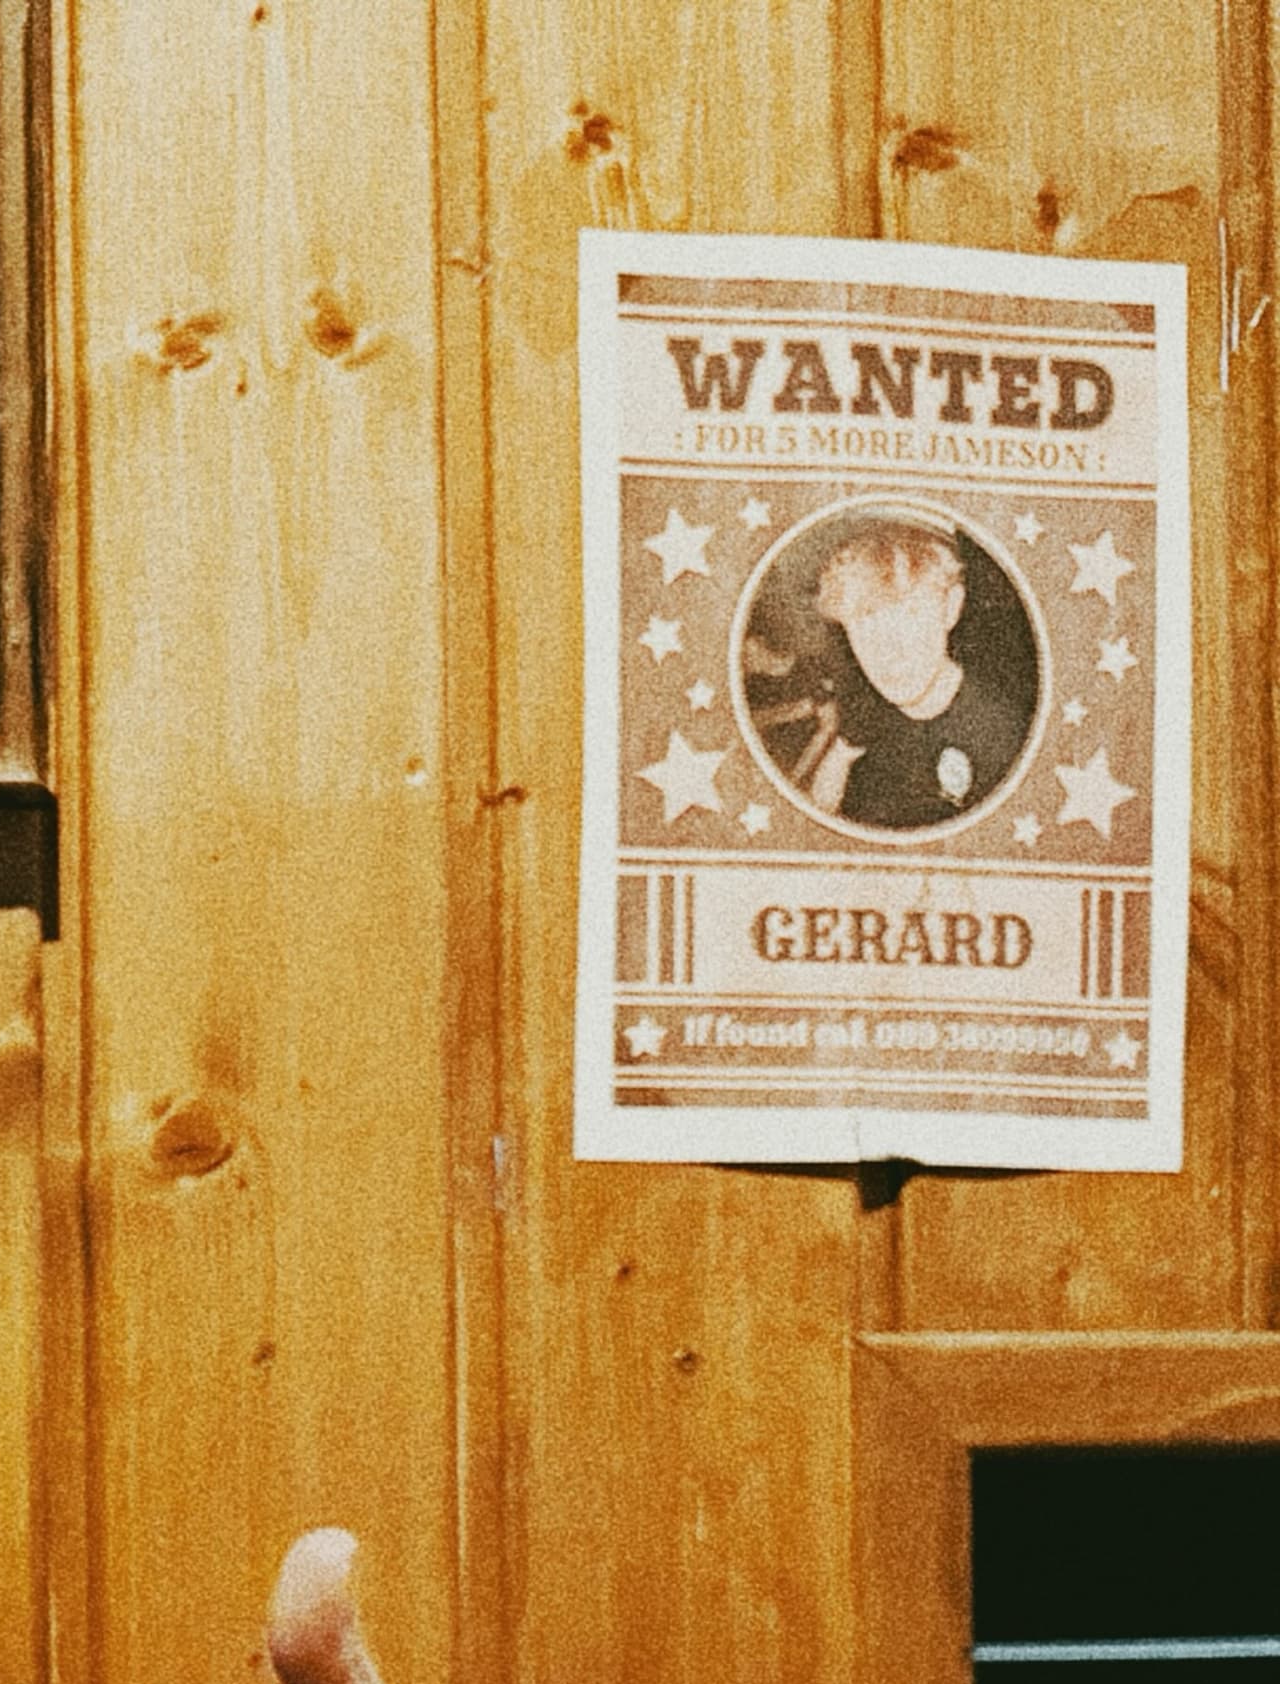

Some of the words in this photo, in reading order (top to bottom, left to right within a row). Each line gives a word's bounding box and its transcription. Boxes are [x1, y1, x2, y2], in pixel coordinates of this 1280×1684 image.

[666, 337, 1116, 432] WANTED
[695, 425, 766, 454] FOR
[776, 426, 798, 453] 5
[809, 427, 914, 460] MORE
[922, 435, 1095, 470] JAMESON
[751, 907, 1033, 968] GERARD
[715, 1014, 808, 1046] found
